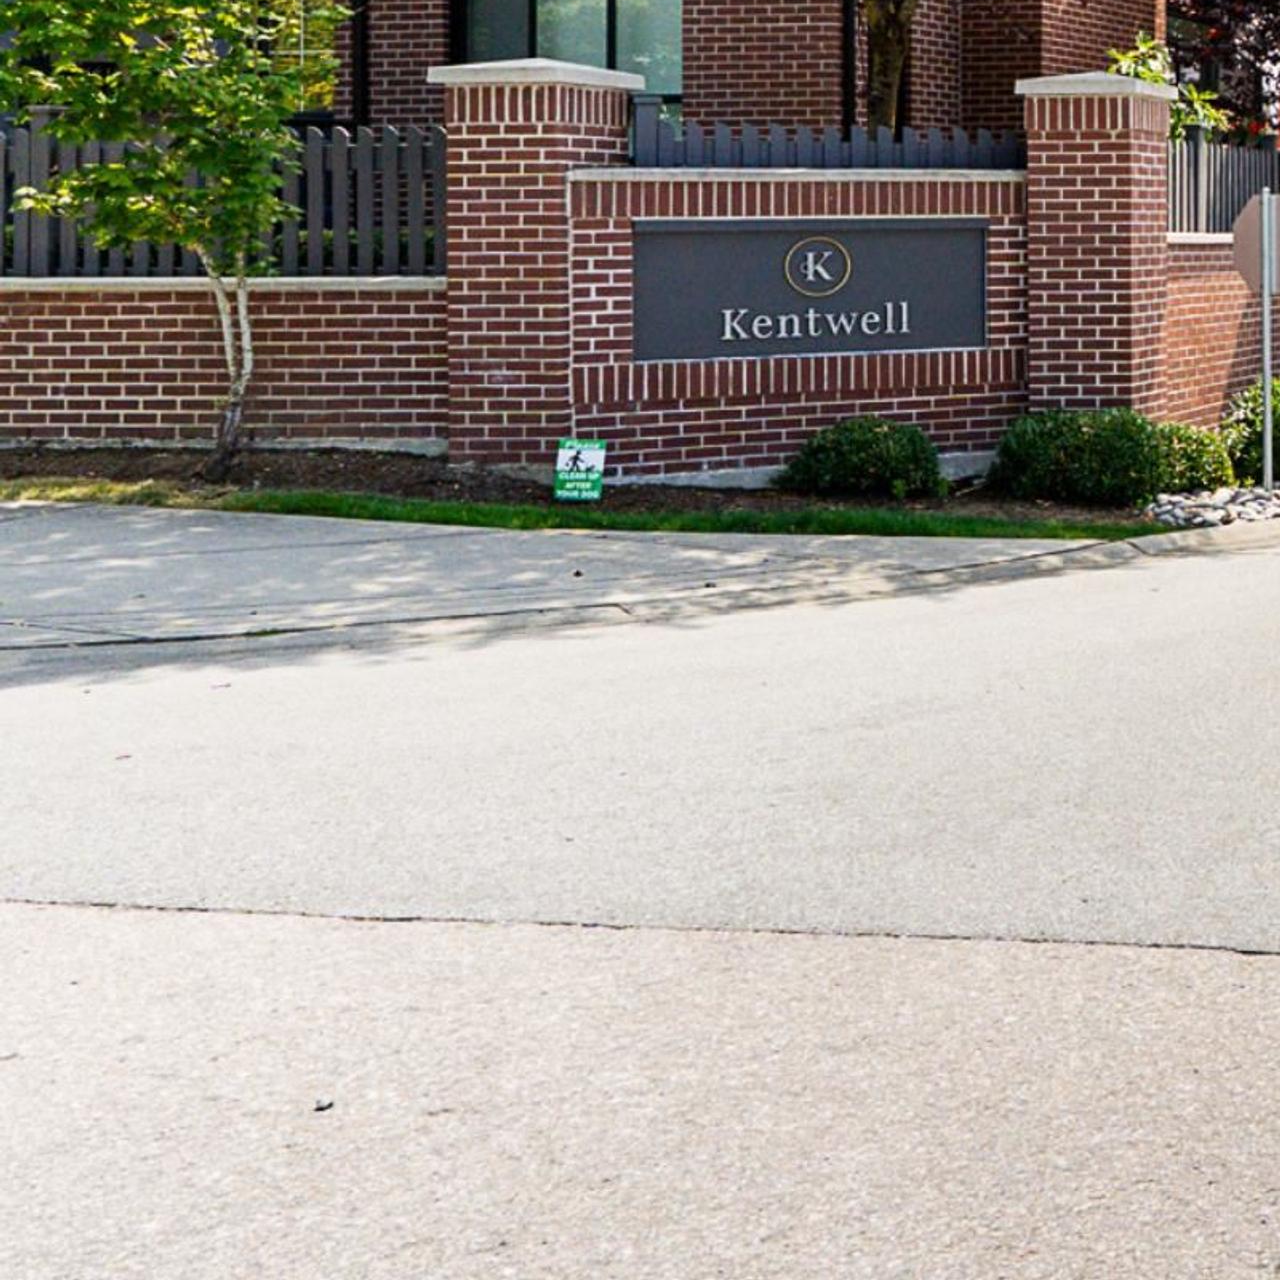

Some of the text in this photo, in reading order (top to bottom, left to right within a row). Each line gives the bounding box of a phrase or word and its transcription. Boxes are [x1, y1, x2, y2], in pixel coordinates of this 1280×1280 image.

[720, 301, 910, 341] Kentwell
[558, 471, 600, 480] CLEAN UP
[564, 481, 592, 490] AFTER
